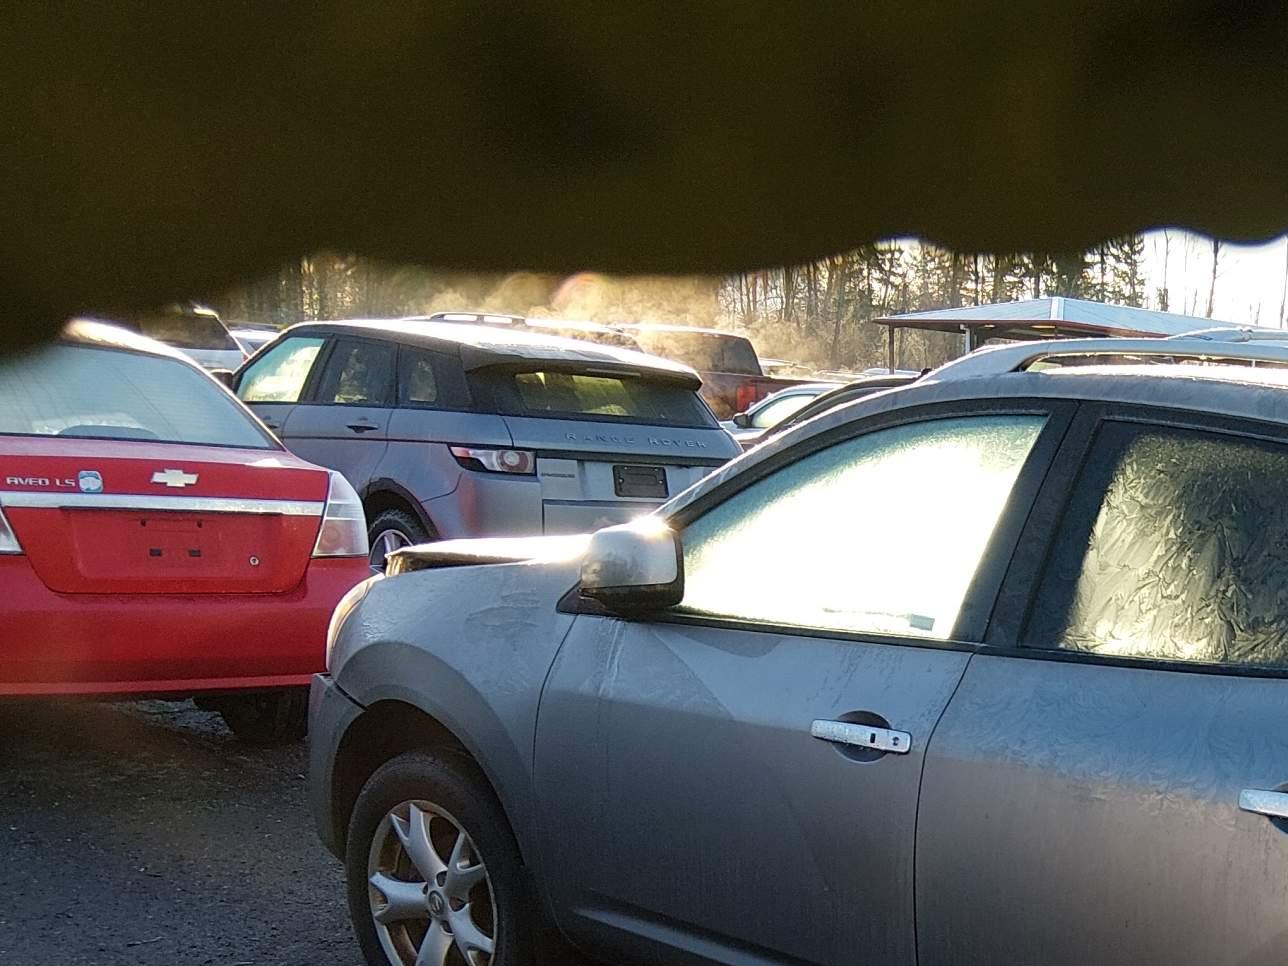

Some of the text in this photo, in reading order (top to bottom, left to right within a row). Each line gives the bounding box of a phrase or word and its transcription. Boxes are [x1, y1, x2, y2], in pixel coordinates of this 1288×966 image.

[648, 437, 707, 448] ROVER
[6, 477, 76, 487] AVEO LS
